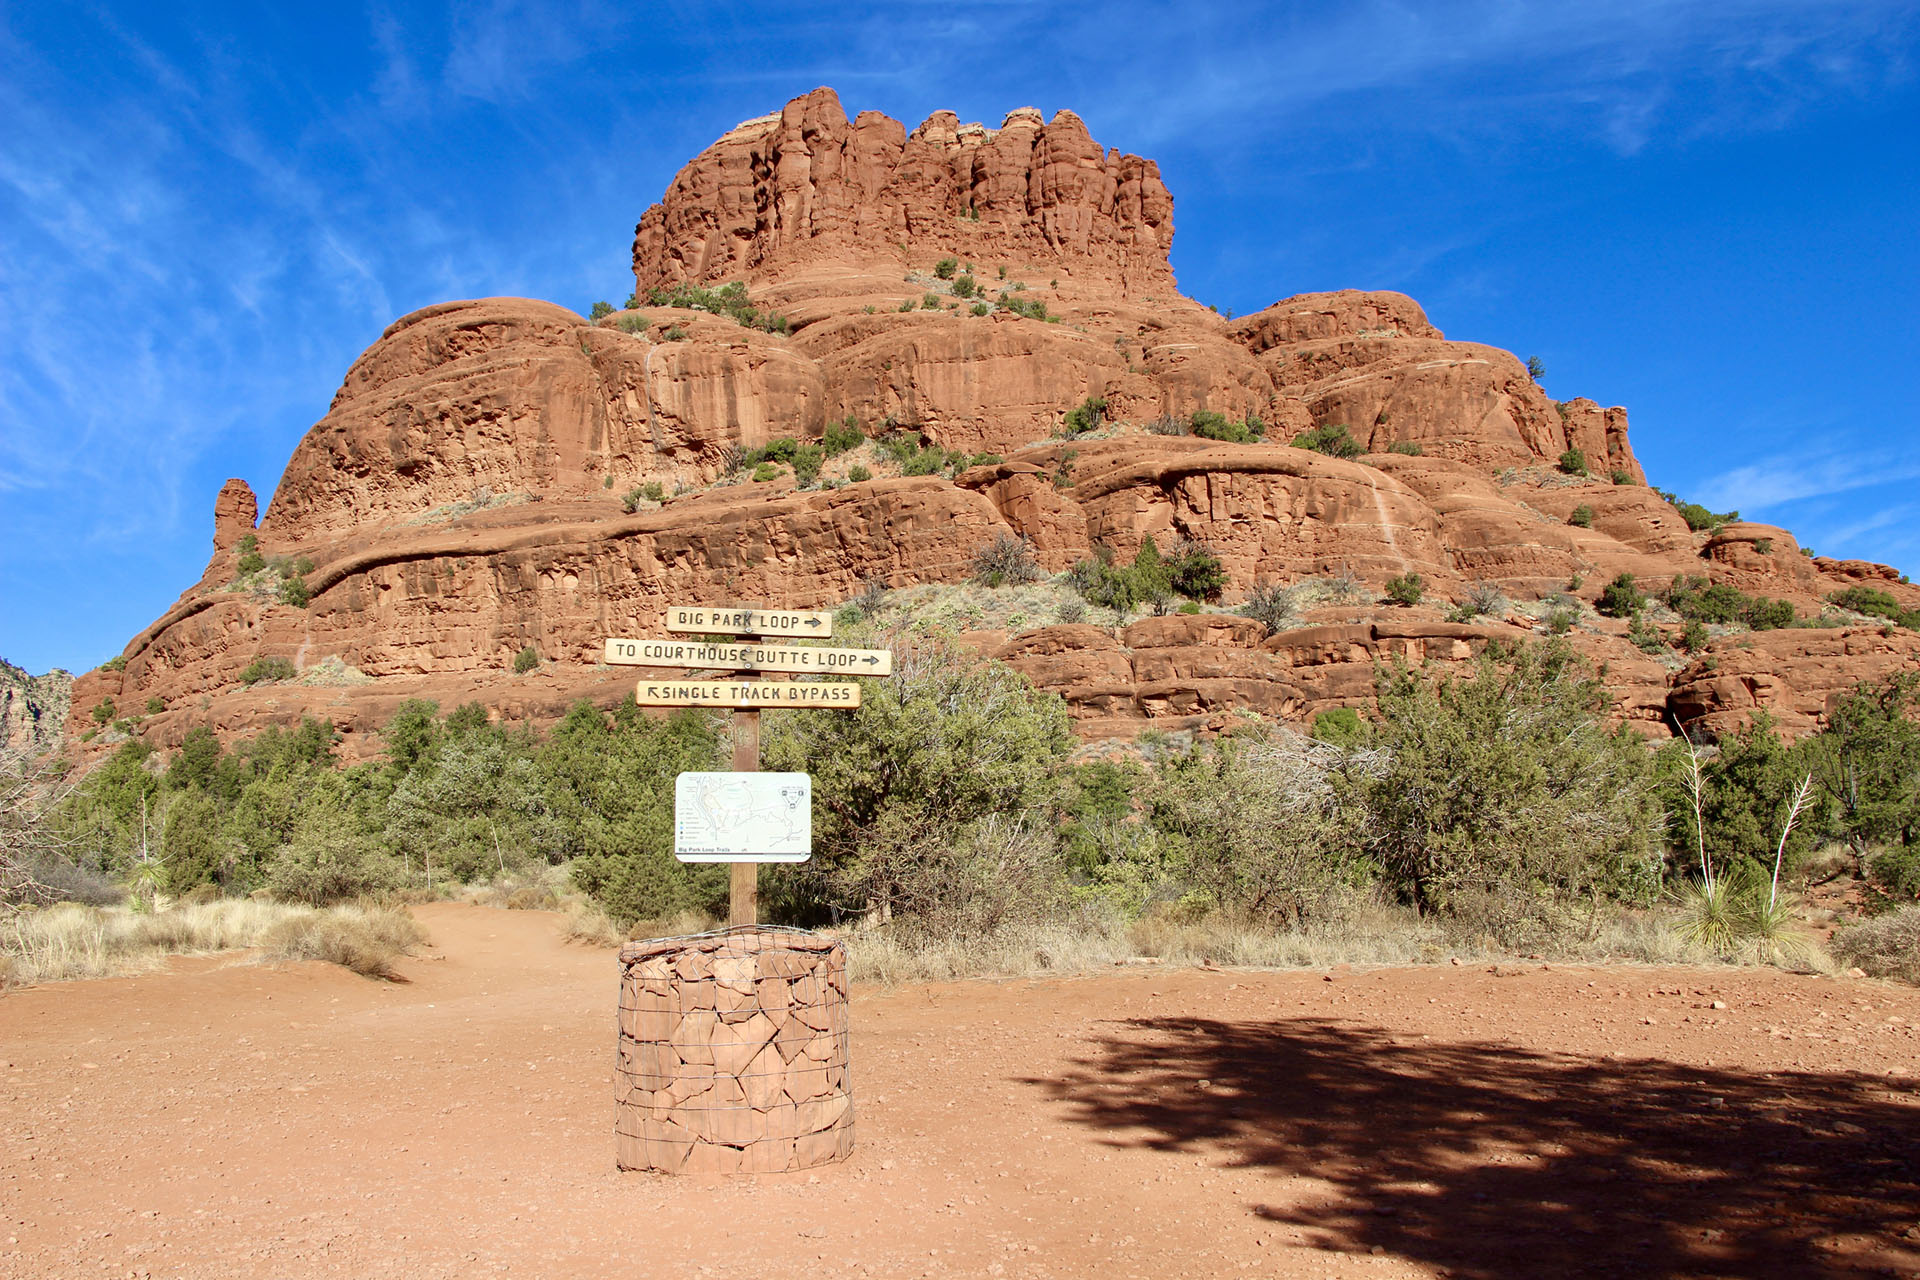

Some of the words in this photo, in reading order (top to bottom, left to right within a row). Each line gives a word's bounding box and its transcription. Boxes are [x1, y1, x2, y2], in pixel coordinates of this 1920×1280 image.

[679, 612, 704, 625] BIG
[712, 613, 752, 627] PARK
[760, 615, 800, 629] LOOP
[616, 643, 636, 657] TO
[644, 645, 748, 661] COURTHOUSE
[756, 650, 810, 664] BUTTE
[818, 654, 858, 666] LOOP
[662, 686, 720, 699] SINGLE
[731, 687, 781, 700] TRACK
[789, 687, 851, 700] BYPASS
